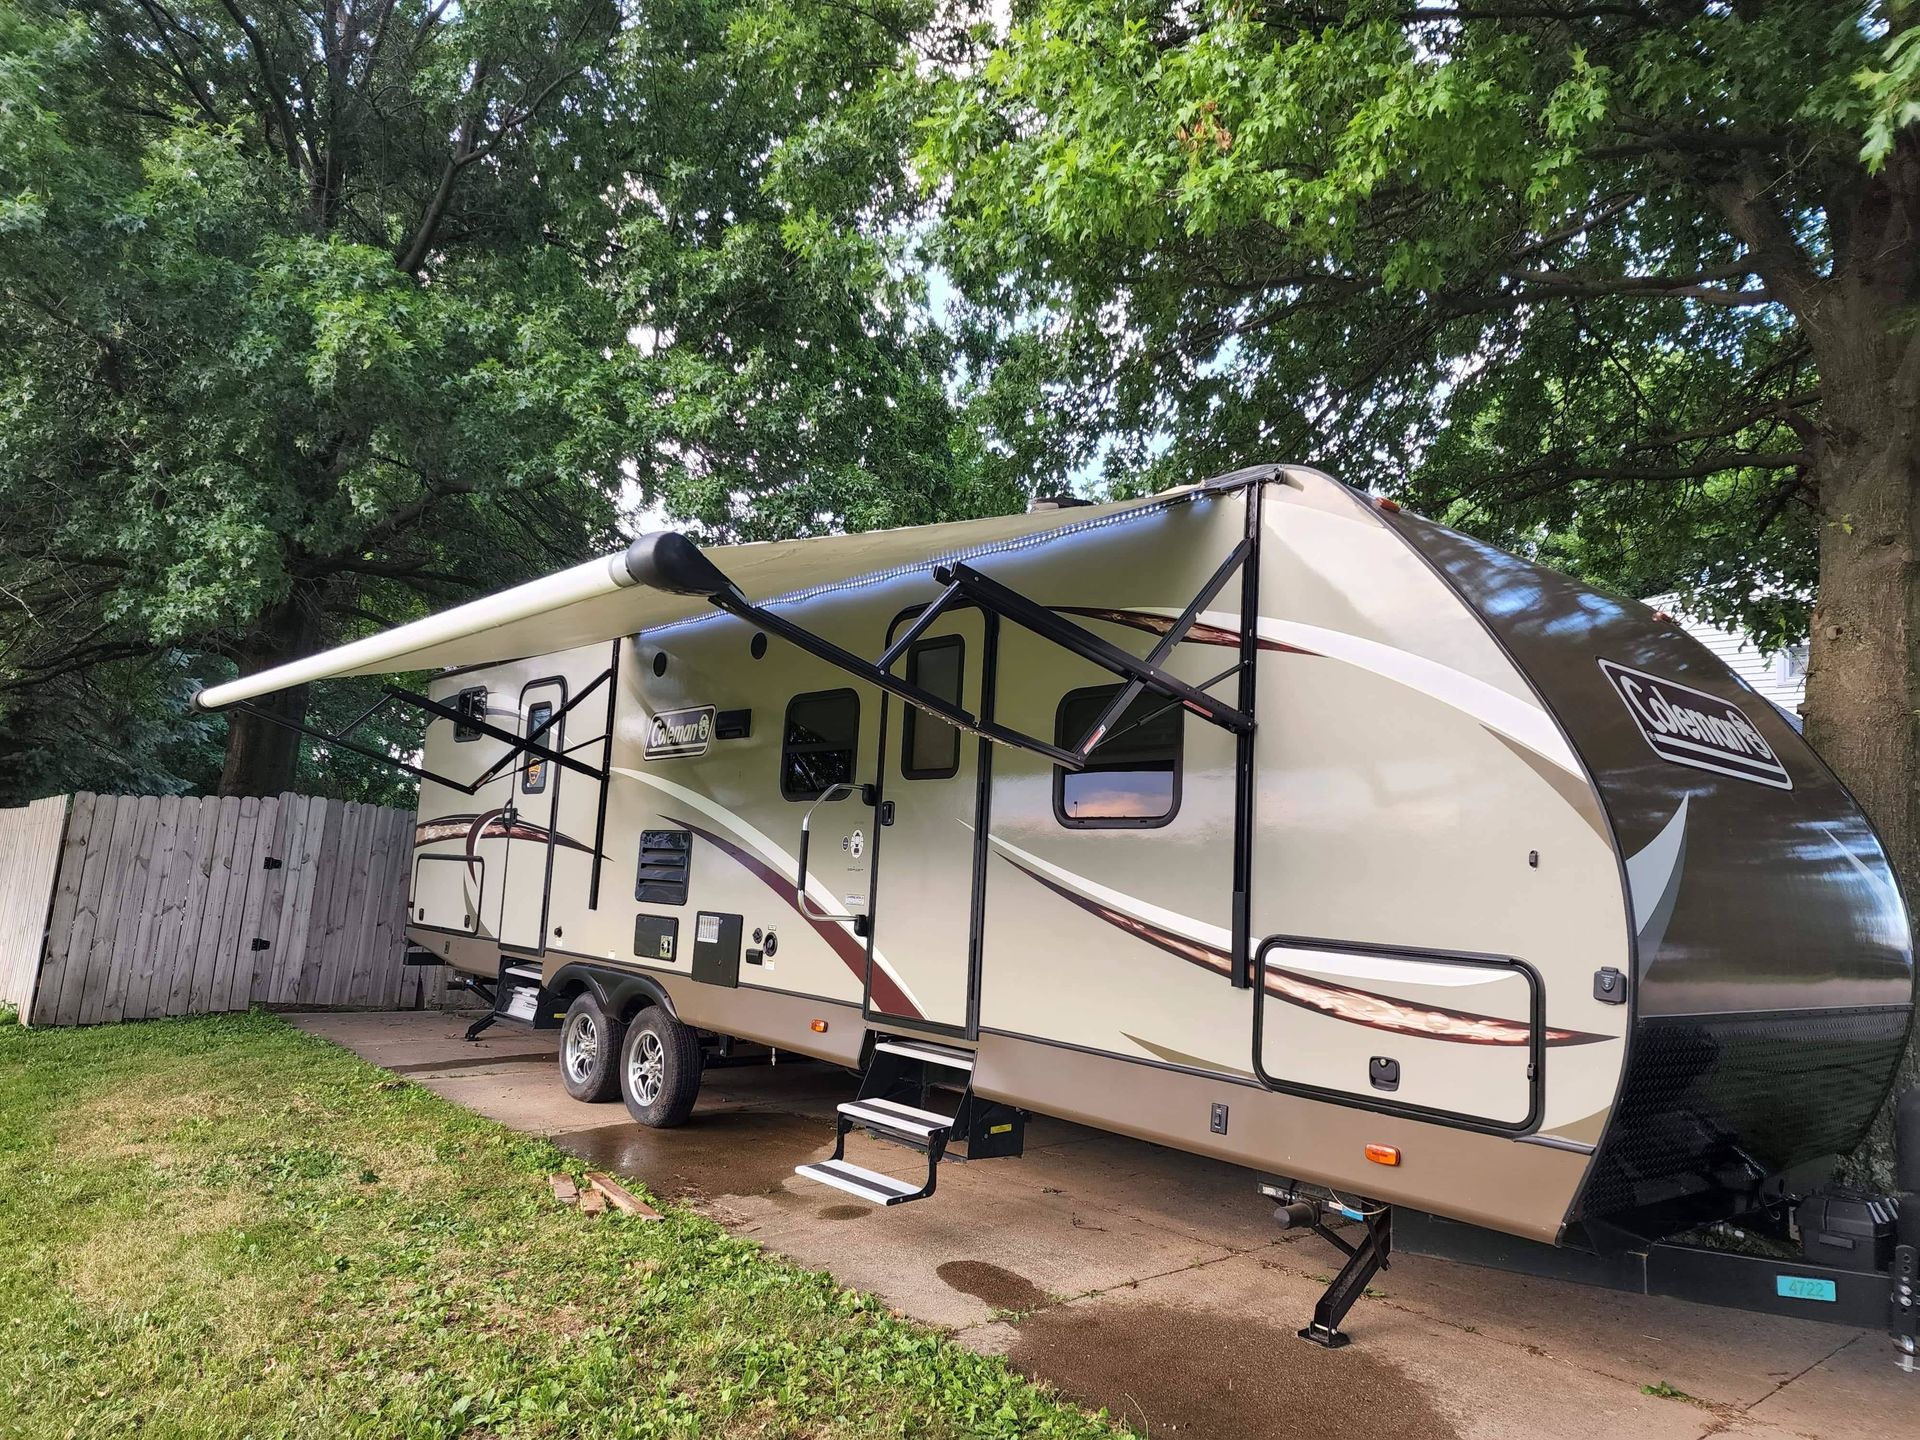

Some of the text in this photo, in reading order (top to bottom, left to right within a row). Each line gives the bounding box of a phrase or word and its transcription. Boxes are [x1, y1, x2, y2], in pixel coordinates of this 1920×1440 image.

[1620, 675, 1753, 754] Coleman
[651, 718, 698, 747] Coleman
[1789, 1280, 1824, 1297] 4722
